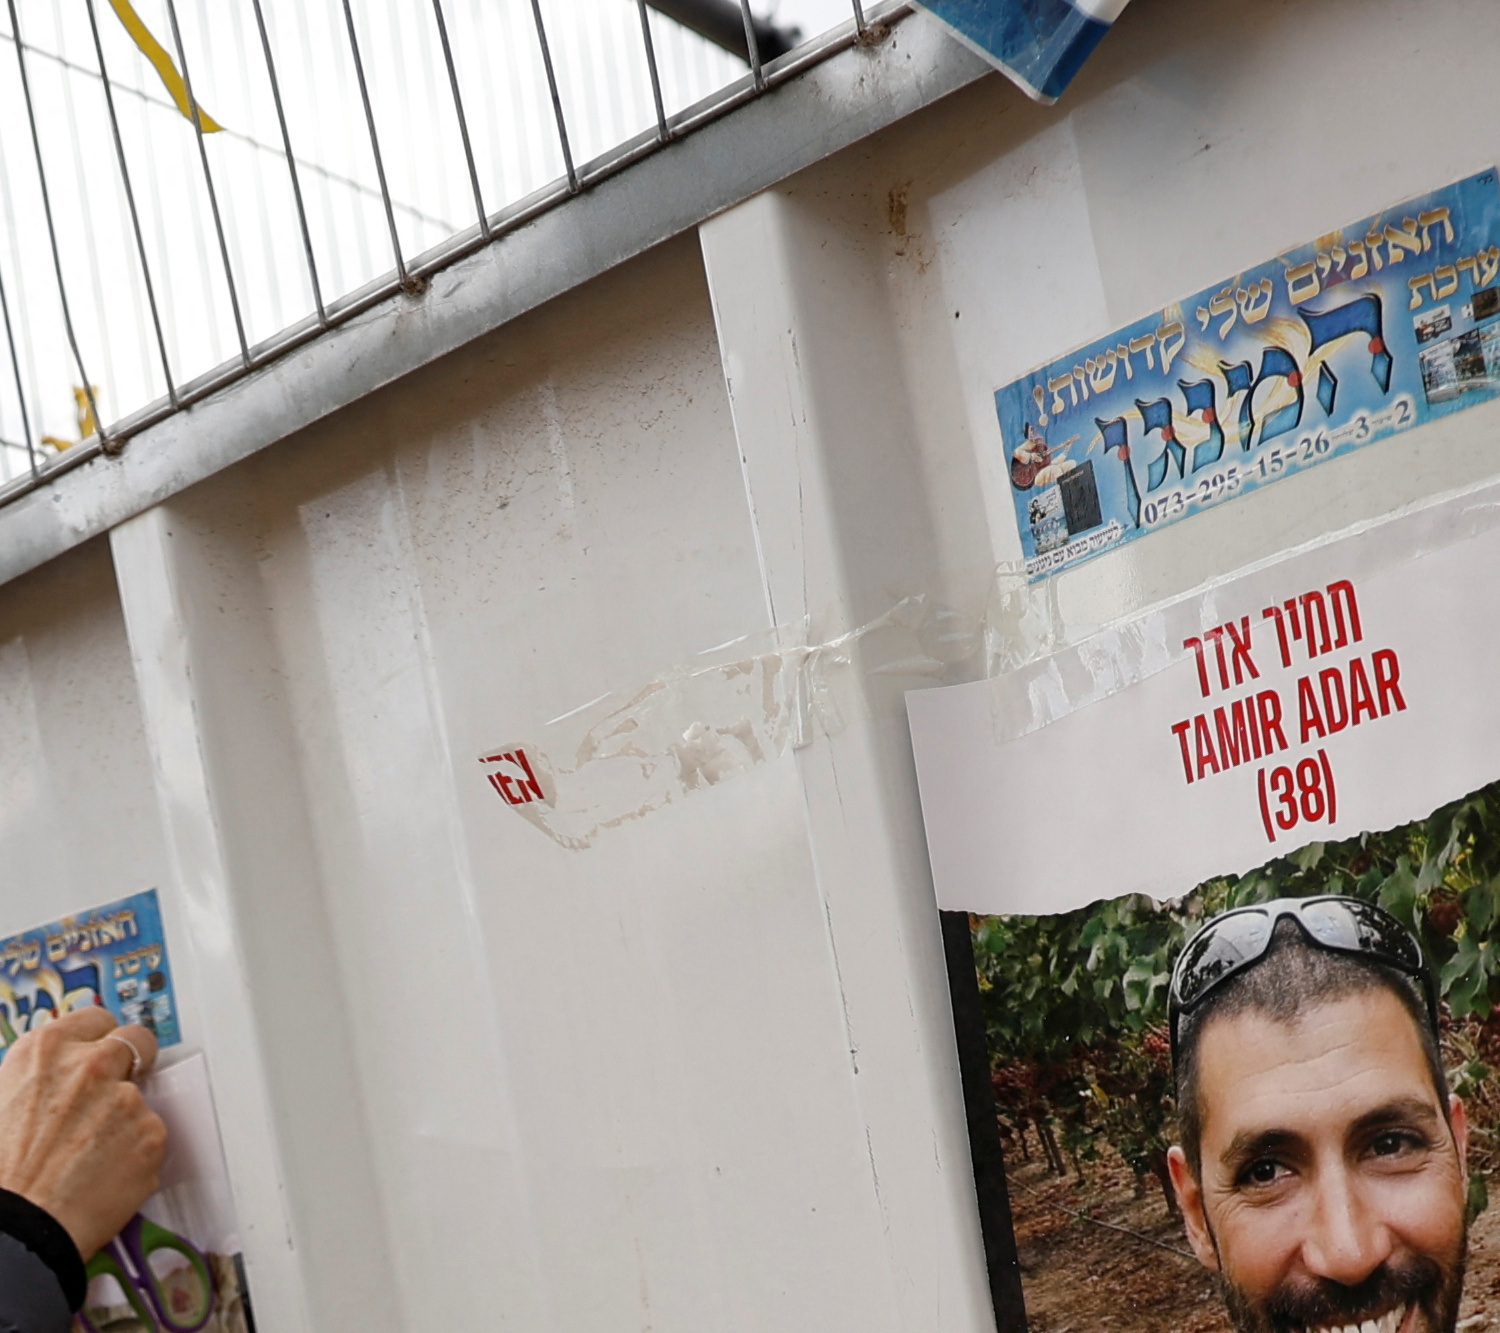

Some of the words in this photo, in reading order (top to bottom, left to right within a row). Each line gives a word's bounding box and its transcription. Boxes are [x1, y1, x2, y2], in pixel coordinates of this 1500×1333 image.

[1285, 205, 1455, 306] האזניים
[1407, 245, 1500, 310] ערכת
[1196, 276, 1273, 341] שלי
[1032, 321, 1186, 427] קדושות!
[1095, 291, 1394, 529] המנגן
[1182, 615, 1260, 698] אדר
[1262, 579, 1363, 669] תמיר
[1171, 689, 1290, 785] TAMIR
[1297, 648, 1408, 745] ADAR
[1257, 748, 1337, 843] (38)
